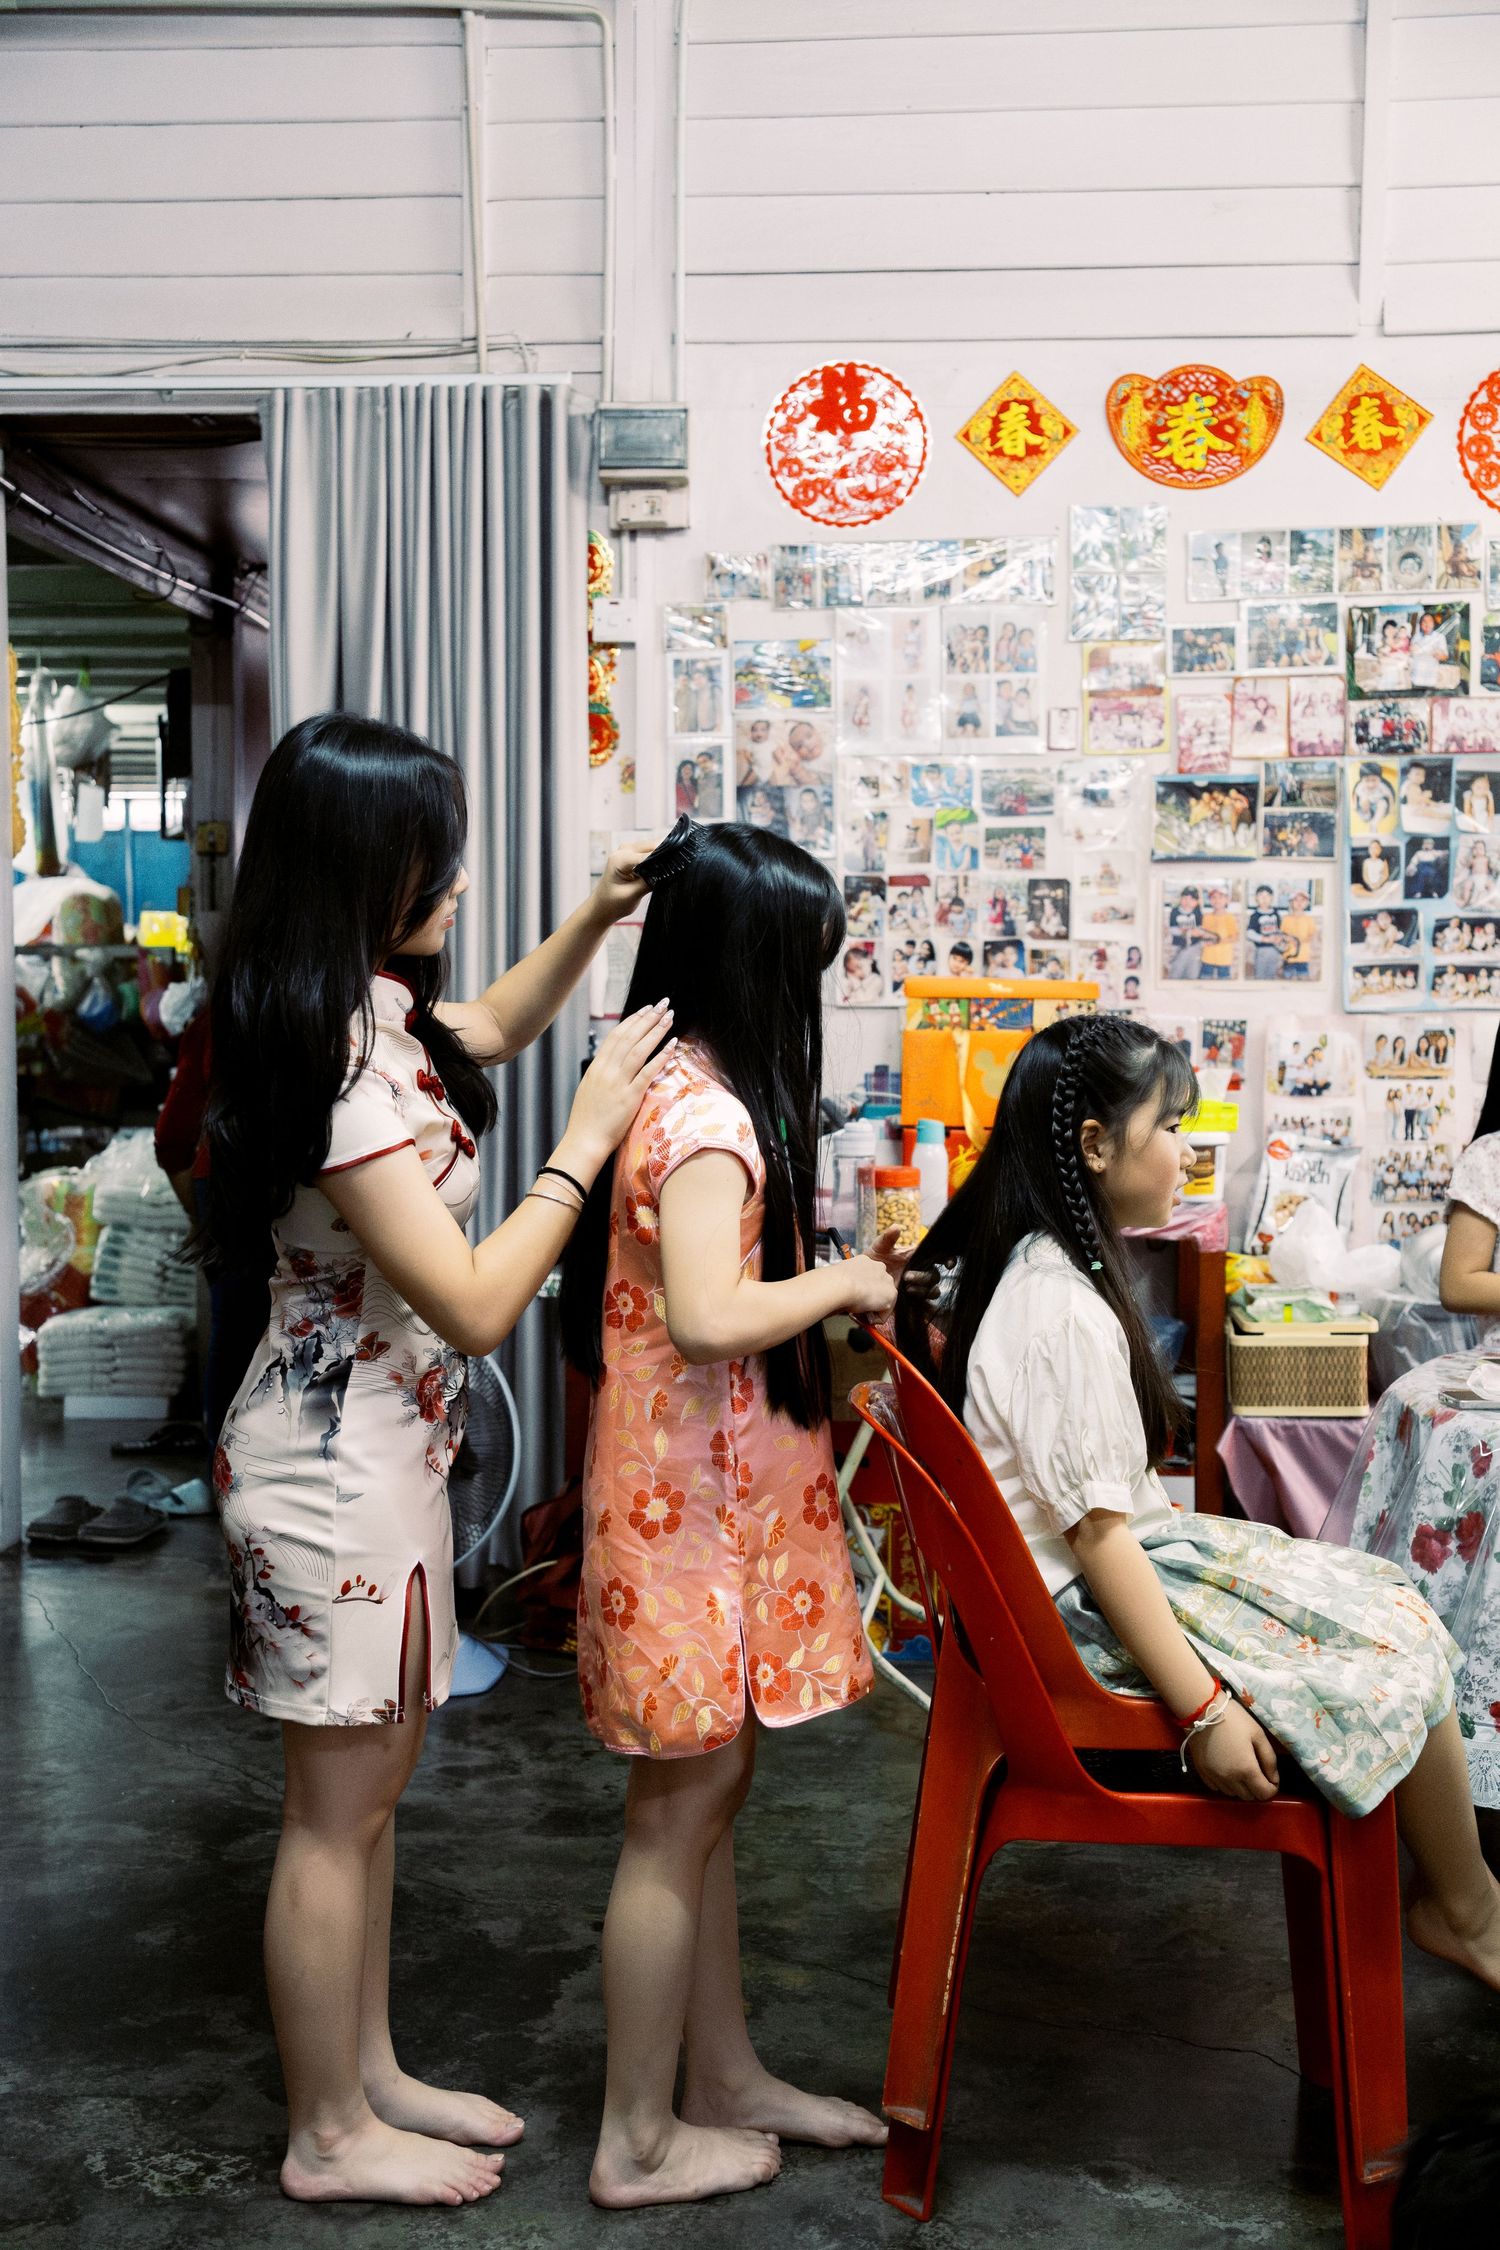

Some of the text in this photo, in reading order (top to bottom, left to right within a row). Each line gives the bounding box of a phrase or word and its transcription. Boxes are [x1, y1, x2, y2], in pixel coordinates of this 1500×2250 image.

[990, 401, 1044, 458] 春
[1152, 392, 1236, 471] 春
[1346, 396, 1401, 451] 春
